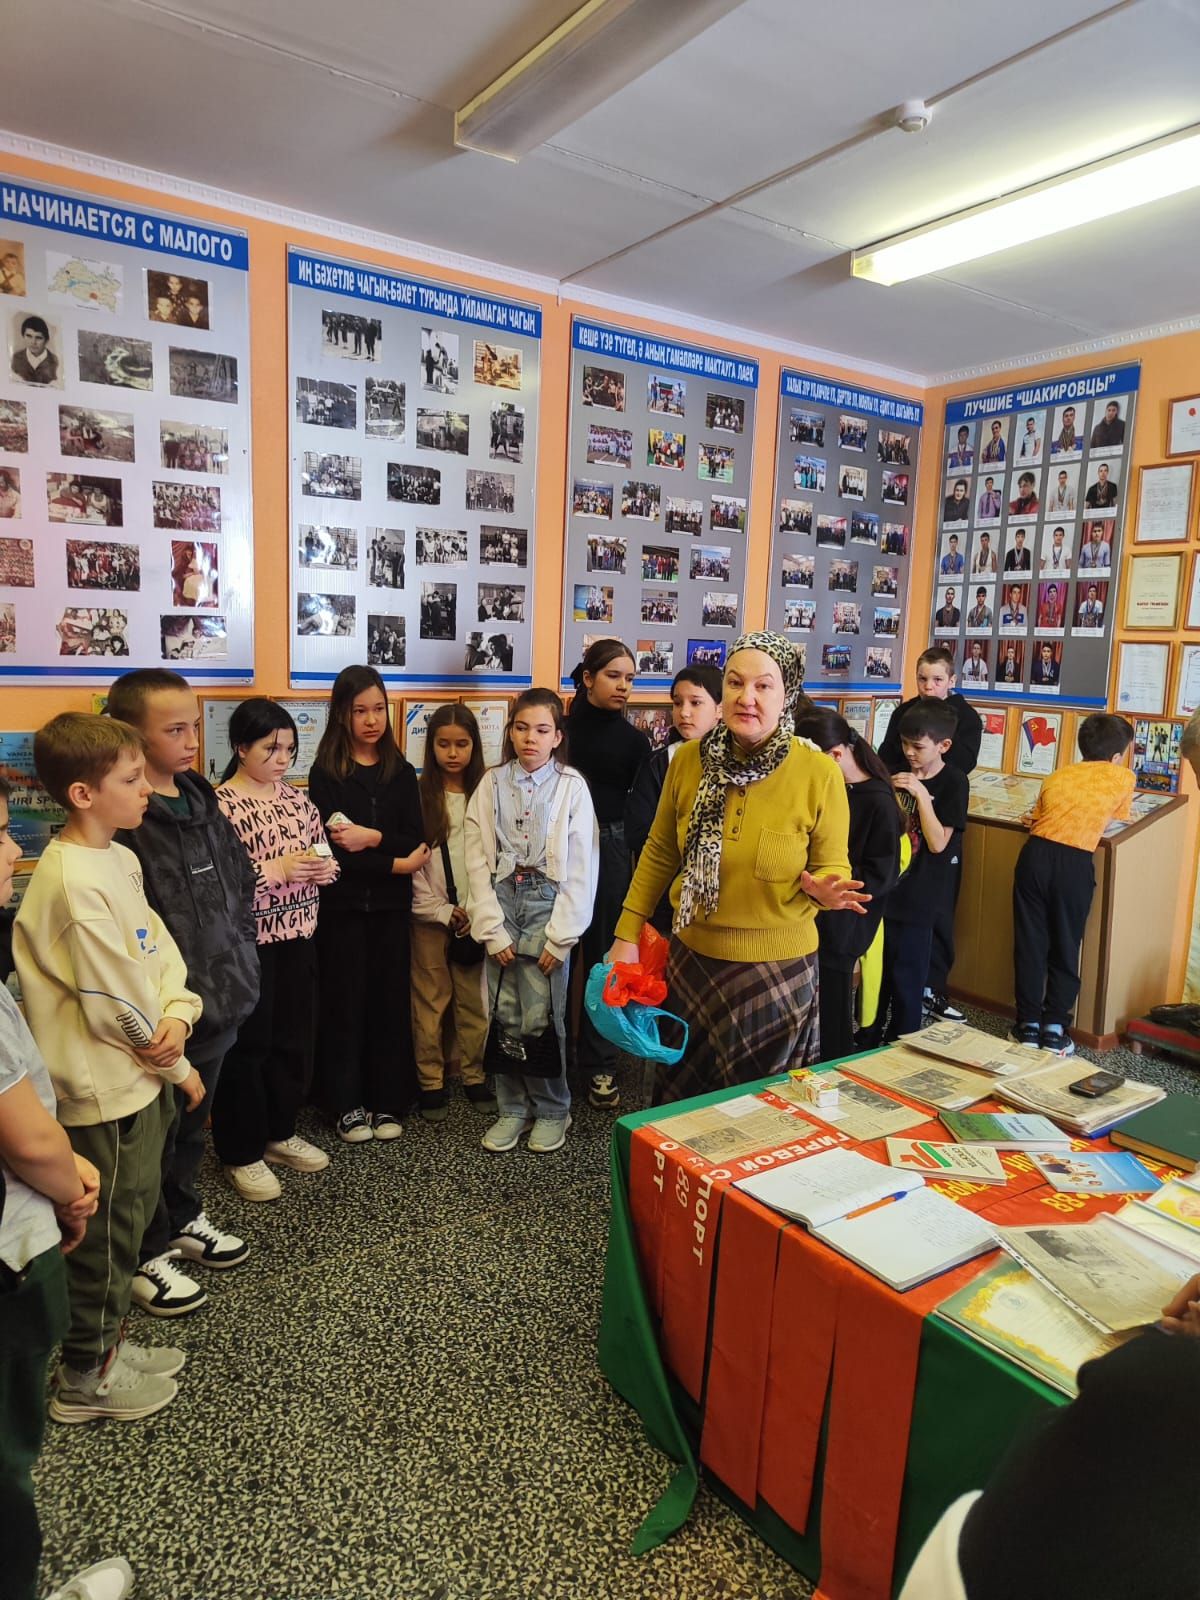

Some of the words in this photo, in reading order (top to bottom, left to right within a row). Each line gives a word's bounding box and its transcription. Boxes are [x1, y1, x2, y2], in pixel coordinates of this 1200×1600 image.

[2, 187, 136, 240] НАЧИНАЕТСЯ
[142, 220, 154, 244] С
[160, 224, 233, 262] МАЛОГО
[964, 393, 1013, 417] ЛУЧШИЕ
[411, 726, 428, 735] ДИП
[737, 1131, 851, 1172] ГИРЕВОЙ
